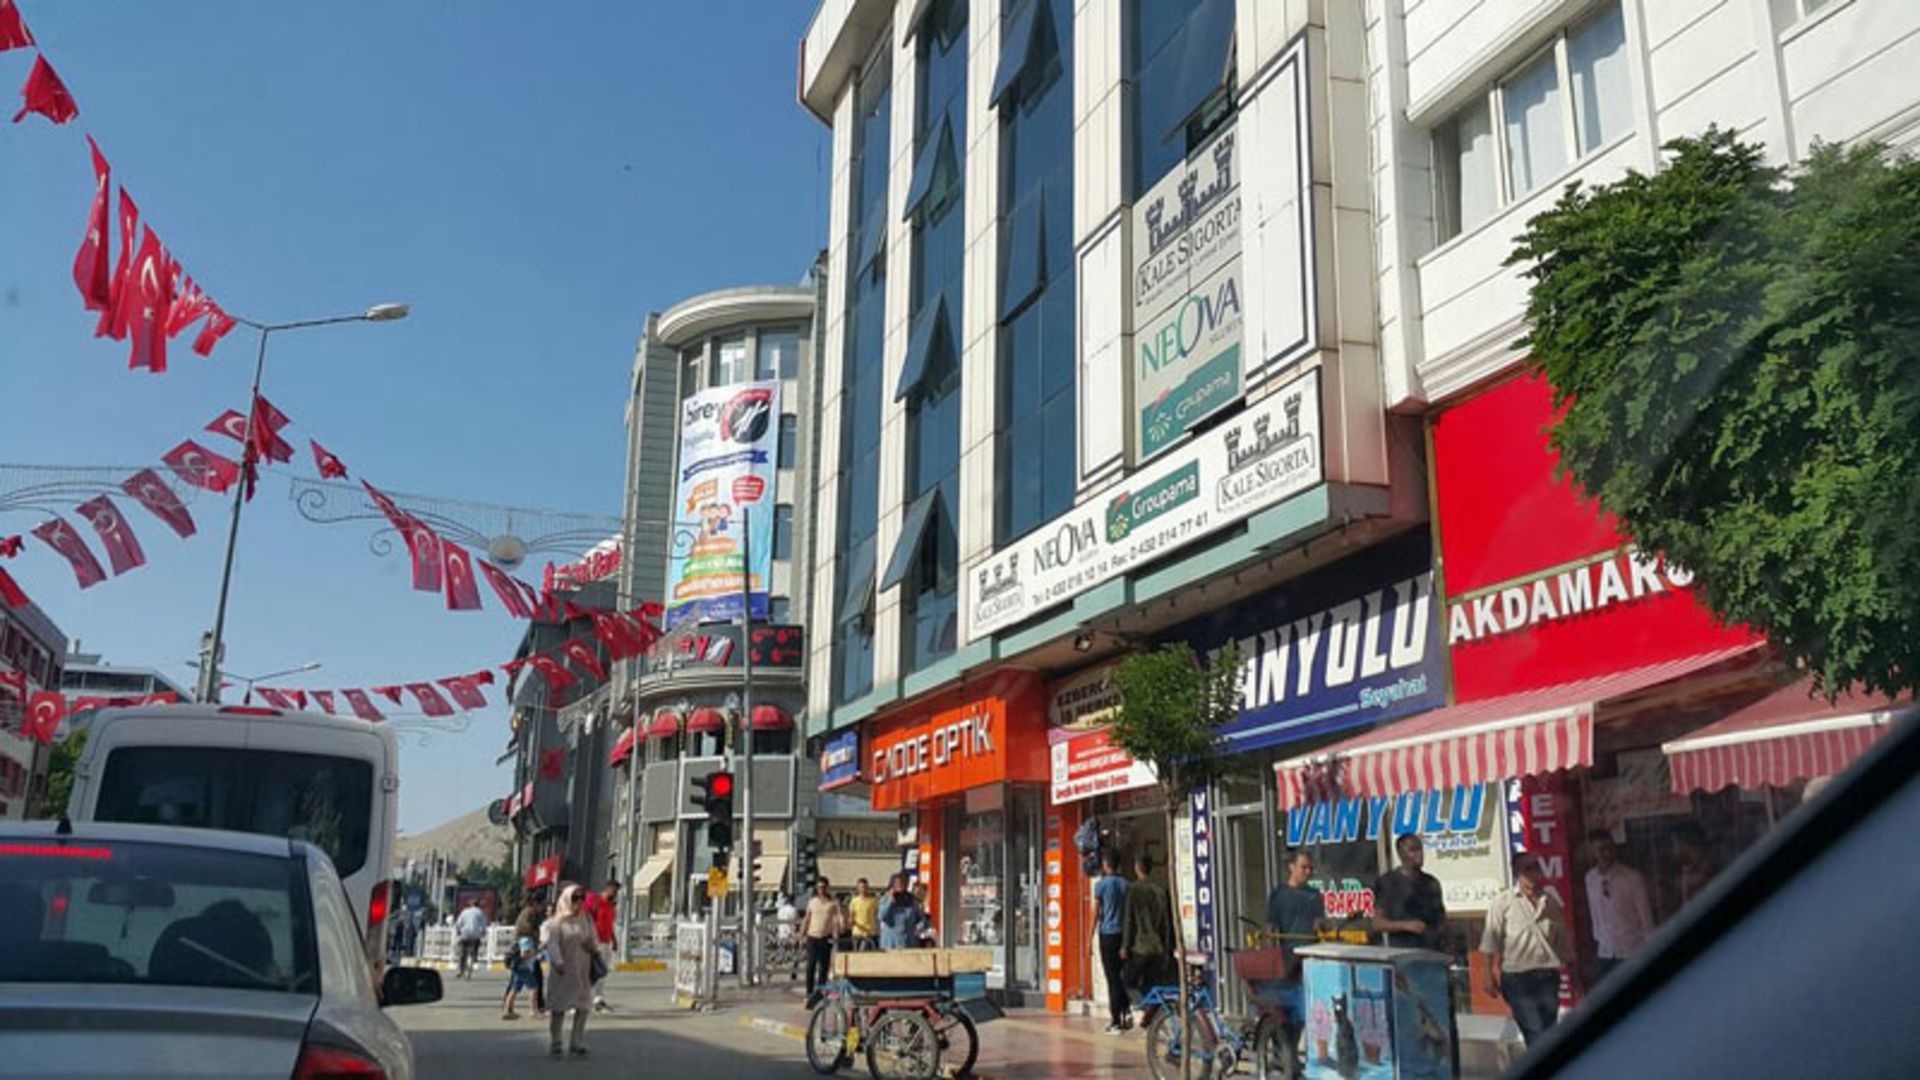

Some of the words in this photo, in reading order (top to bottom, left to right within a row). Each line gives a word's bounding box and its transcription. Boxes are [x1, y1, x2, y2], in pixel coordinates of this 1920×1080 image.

[1141, 277, 1240, 382] NEOVA
[1132, 474, 1196, 519] Groupama
[1220, 472, 1254, 505] KALE
[1033, 517, 1098, 576] NEOVA
[1208, 572, 1435, 717] ANYOLU
[1359, 673, 1427, 710] Seyahat
[1287, 784, 1486, 846] VANYOLU
